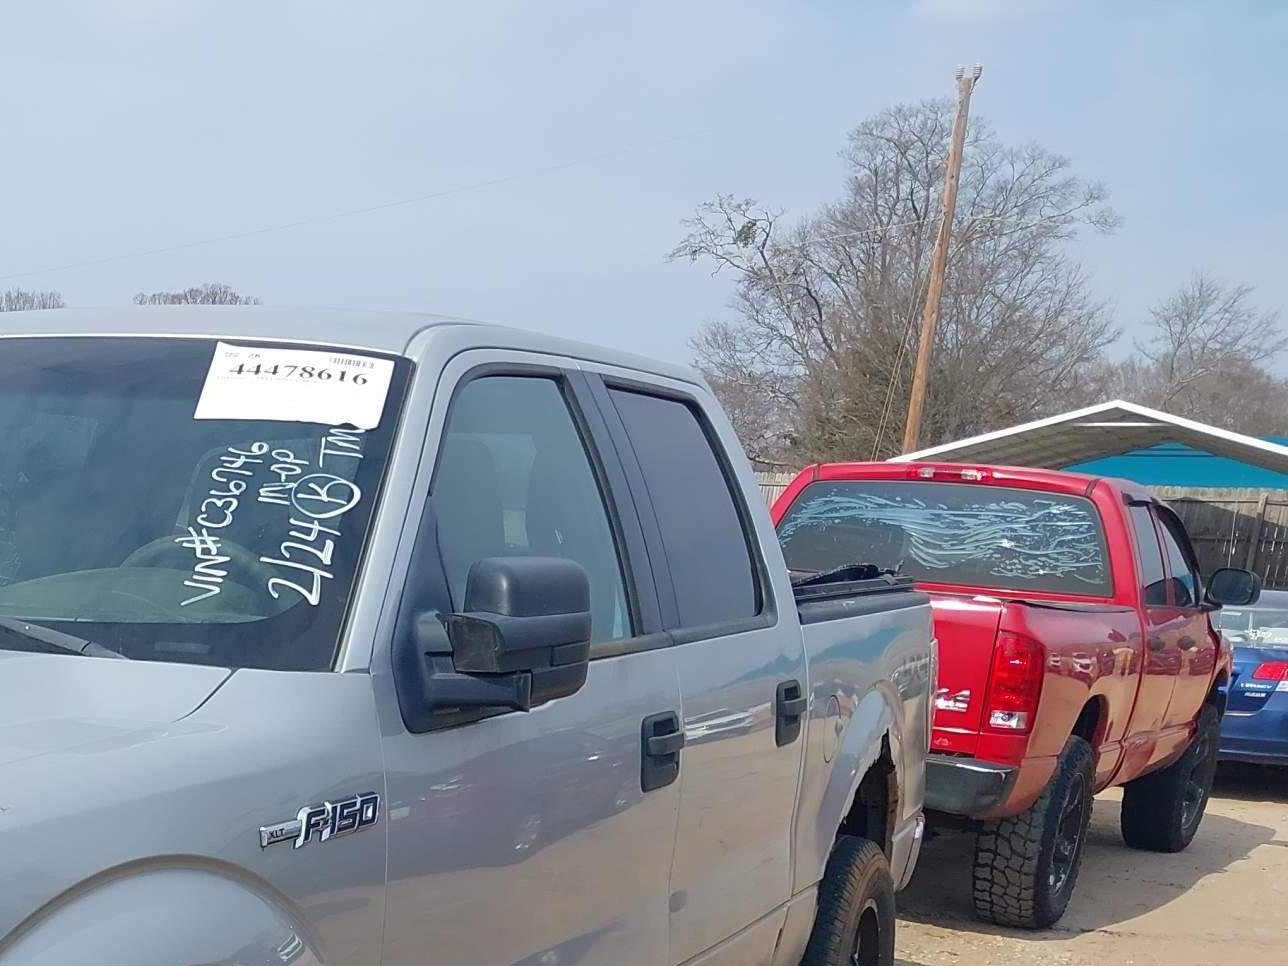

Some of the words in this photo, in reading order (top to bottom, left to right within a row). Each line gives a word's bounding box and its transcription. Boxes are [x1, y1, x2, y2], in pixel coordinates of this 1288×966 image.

[229, 363, 368, 386] 44478616
[259, 517, 342, 606] 2/24
[268, 828, 286, 840] XLT
[293, 792, 380, 849] F-150
